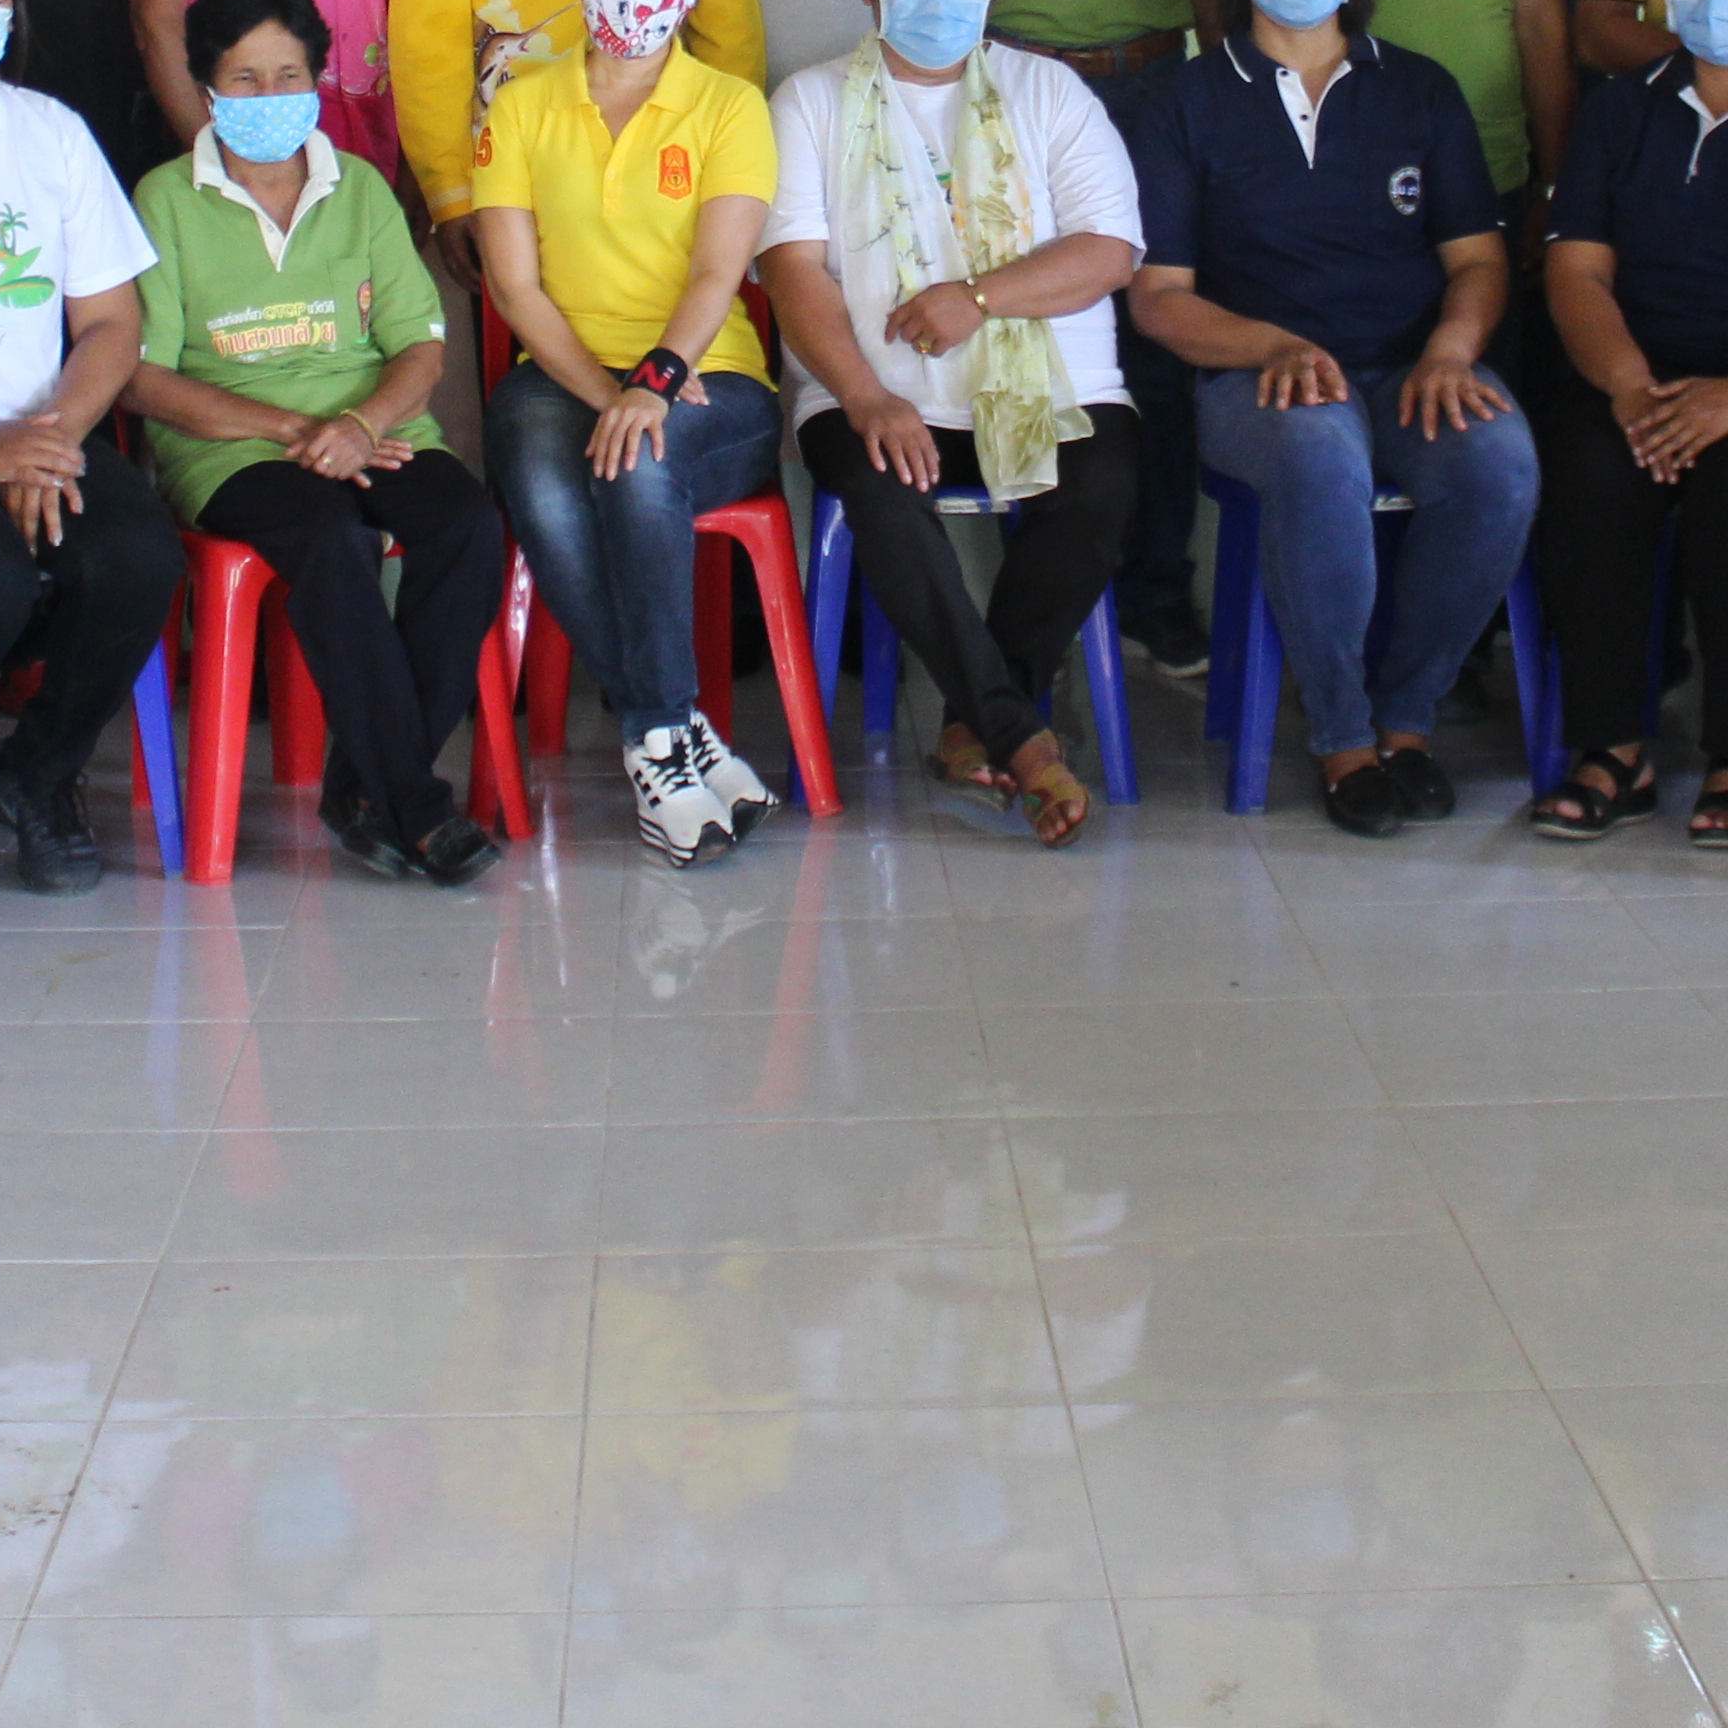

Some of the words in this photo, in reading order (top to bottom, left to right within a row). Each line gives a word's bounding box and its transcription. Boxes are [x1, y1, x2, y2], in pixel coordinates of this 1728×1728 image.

[262, 302, 307, 321] OTOP
[212, 316, 337, 358] บ้านสวนกล้วย
